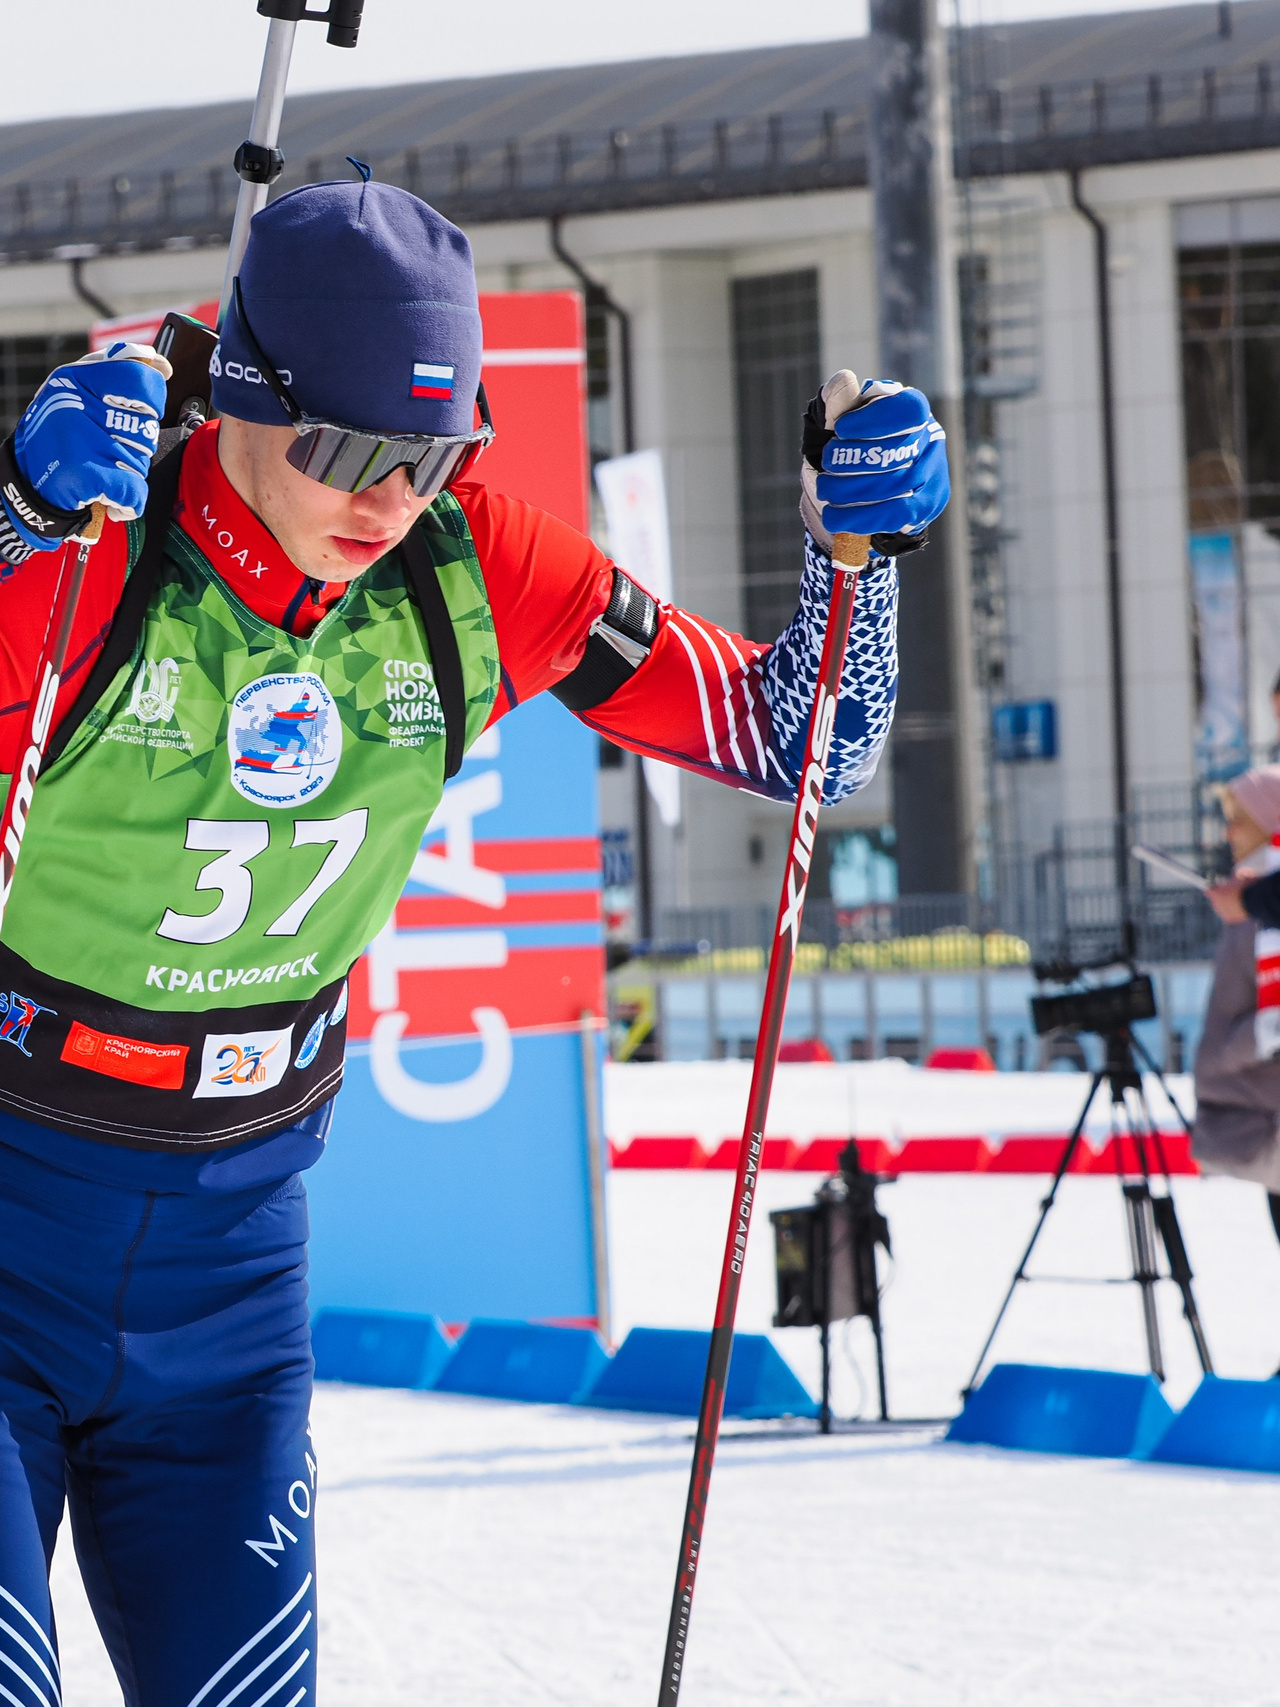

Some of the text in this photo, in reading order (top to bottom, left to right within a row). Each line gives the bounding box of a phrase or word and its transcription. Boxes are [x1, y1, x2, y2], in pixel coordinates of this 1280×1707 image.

[201, 504, 270, 579] MOAX
[387, 701, 446, 724] ЖИЗН
[161, 728, 191, 740] СПОРТА
[389, 736, 425, 748] ПРОЕКТ
[239, 779, 296, 803] Красноярск
[299, 775, 324, 796] 2023
[156, 807, 369, 945] 37
[145, 952, 320, 993] КРАСНОЯРСК
[104, 1045, 130, 1059] КРАЙ
[105, 1038, 180, 1058] КРАСНОЯРСКИЙ
[743, 1131, 762, 1189] TRIAC
